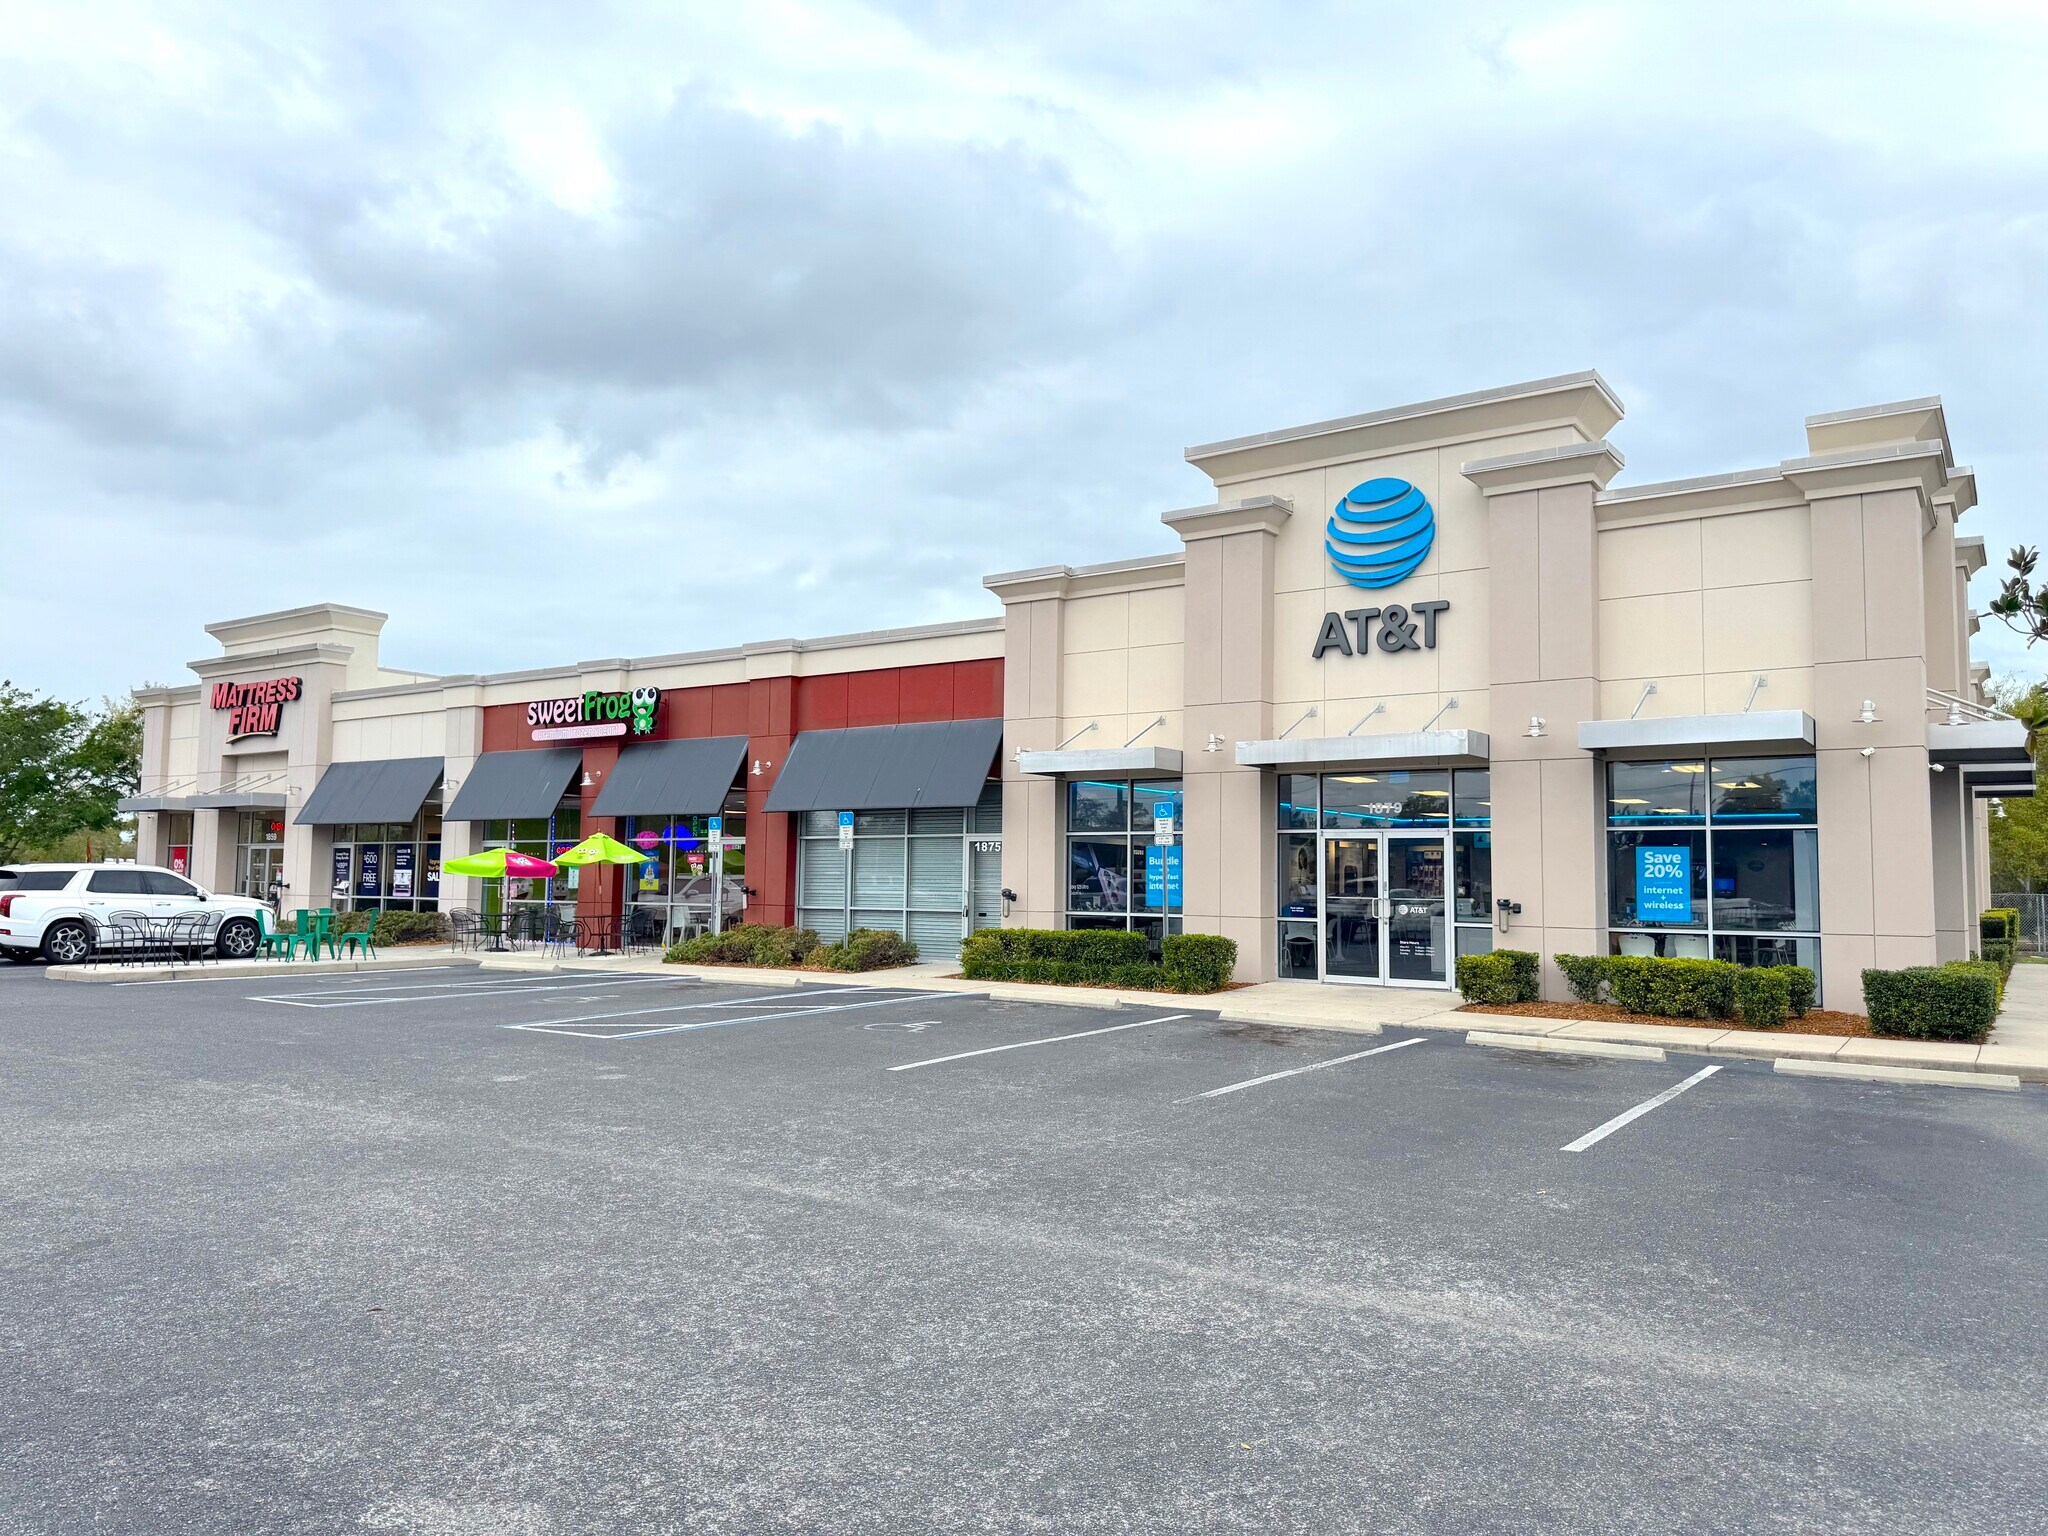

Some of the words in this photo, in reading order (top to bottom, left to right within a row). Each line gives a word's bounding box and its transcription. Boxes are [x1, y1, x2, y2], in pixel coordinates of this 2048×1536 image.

[1312, 600, 1450, 658] AT&T
[210, 677, 301, 709] MATTRESS
[228, 703, 281, 735] FIRM
[1369, 802, 1402, 814] 1879
[974, 841, 1001, 851] 1875
[1644, 851, 1682, 864] Save
[173, 858, 185, 869] 0%
[427, 871, 440, 881] SAL
[1644, 864, 1683, 878] 20%
[362, 872, 377, 882] FREE
[1148, 881, 1180, 890] intenet
[1643, 885, 1684, 895] internet
[1409, 906, 1428, 914] AT&T
[1643, 901, 1684, 910] wireless
